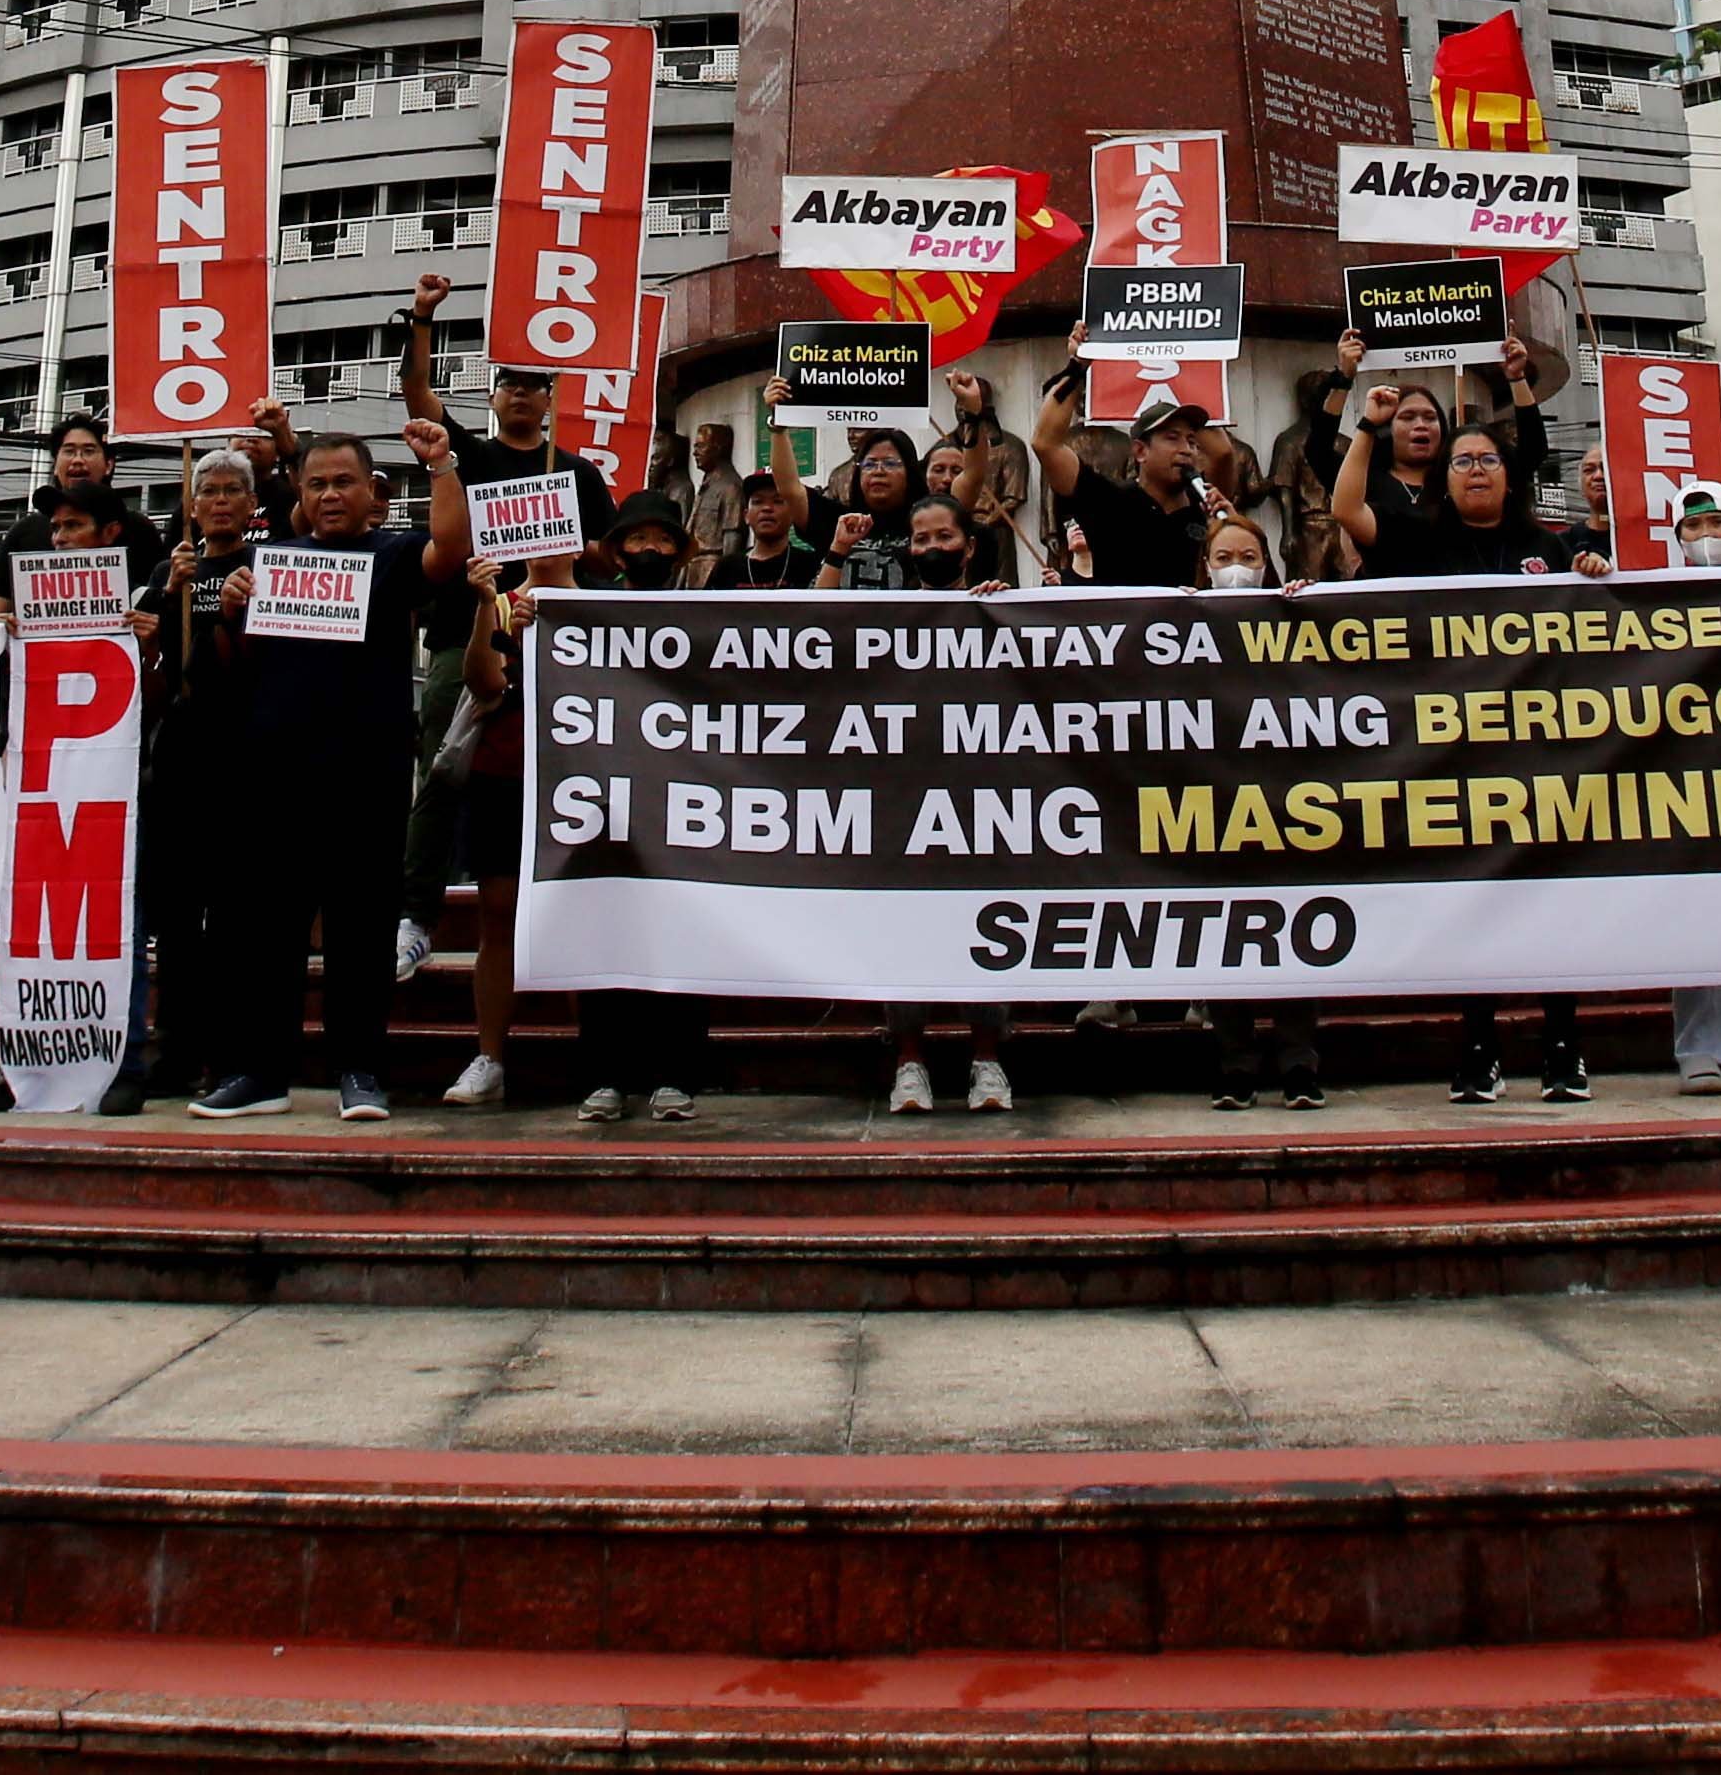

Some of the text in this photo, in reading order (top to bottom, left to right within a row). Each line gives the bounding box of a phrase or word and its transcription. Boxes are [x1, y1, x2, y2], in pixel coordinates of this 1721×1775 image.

[526, 33, 612, 358] SENTRO
[1349, 161, 1570, 207] Akbayan
[791, 189, 1007, 232] Akbayan
[1469, 209, 1568, 241] Party
[153, 71, 230, 422] SENTRO
[909, 235, 1005, 262] Party
[1125, 282, 1202, 305] PBBM
[1359, 281, 1493, 307] Chiz at Martin
[1102, 308, 1222, 332] MANHID!
[1374, 303, 1482, 328] Manloloko!
[788, 345, 919, 364] Chiz at Martin
[1126, 344, 1184, 356] SENTRO
[1403, 348, 1457, 363] SENTRO
[800, 366, 906, 387] Manloloko!
[826, 409, 879, 423] SENTRO
[546, 477, 570, 491] CHIZ
[486, 492, 564, 529] INUTIL
[480, 519, 575, 547] SA WAGE HIKE
[95, 555, 121, 568] CHIZ
[341, 558, 367, 572] CHIZ
[30, 570, 113, 601] INUTIL
[269, 568, 355, 603] TAKSIL
[23, 598, 123, 619] SA WAGE HIKE
[257, 600, 360, 621] SA MANGGAGAWA
[252, 620, 292, 630] PARTIDO
[551, 626, 691, 670] SINO
[710, 627, 833, 670] ANG
[855, 623, 1126, 670] PUMATAY
[1144, 622, 1222, 666] SA
[1237, 617, 1410, 664] WAGE
[550, 694, 615, 746] SI
[640, 701, 807, 755] CHIZ
[828, 703, 917, 754] AT
[942, 697, 1215, 754] MARTIN
[1239, 694, 1389, 749] ANG
[8, 638, 136, 962] PM
[549, 775, 632, 846] SI
[665, 781, 873, 856] BBM
[904, 787, 1103, 856] ANG
[969, 896, 1357, 971] SENTRO
[18, 978, 107, 1022] PARTIDO
